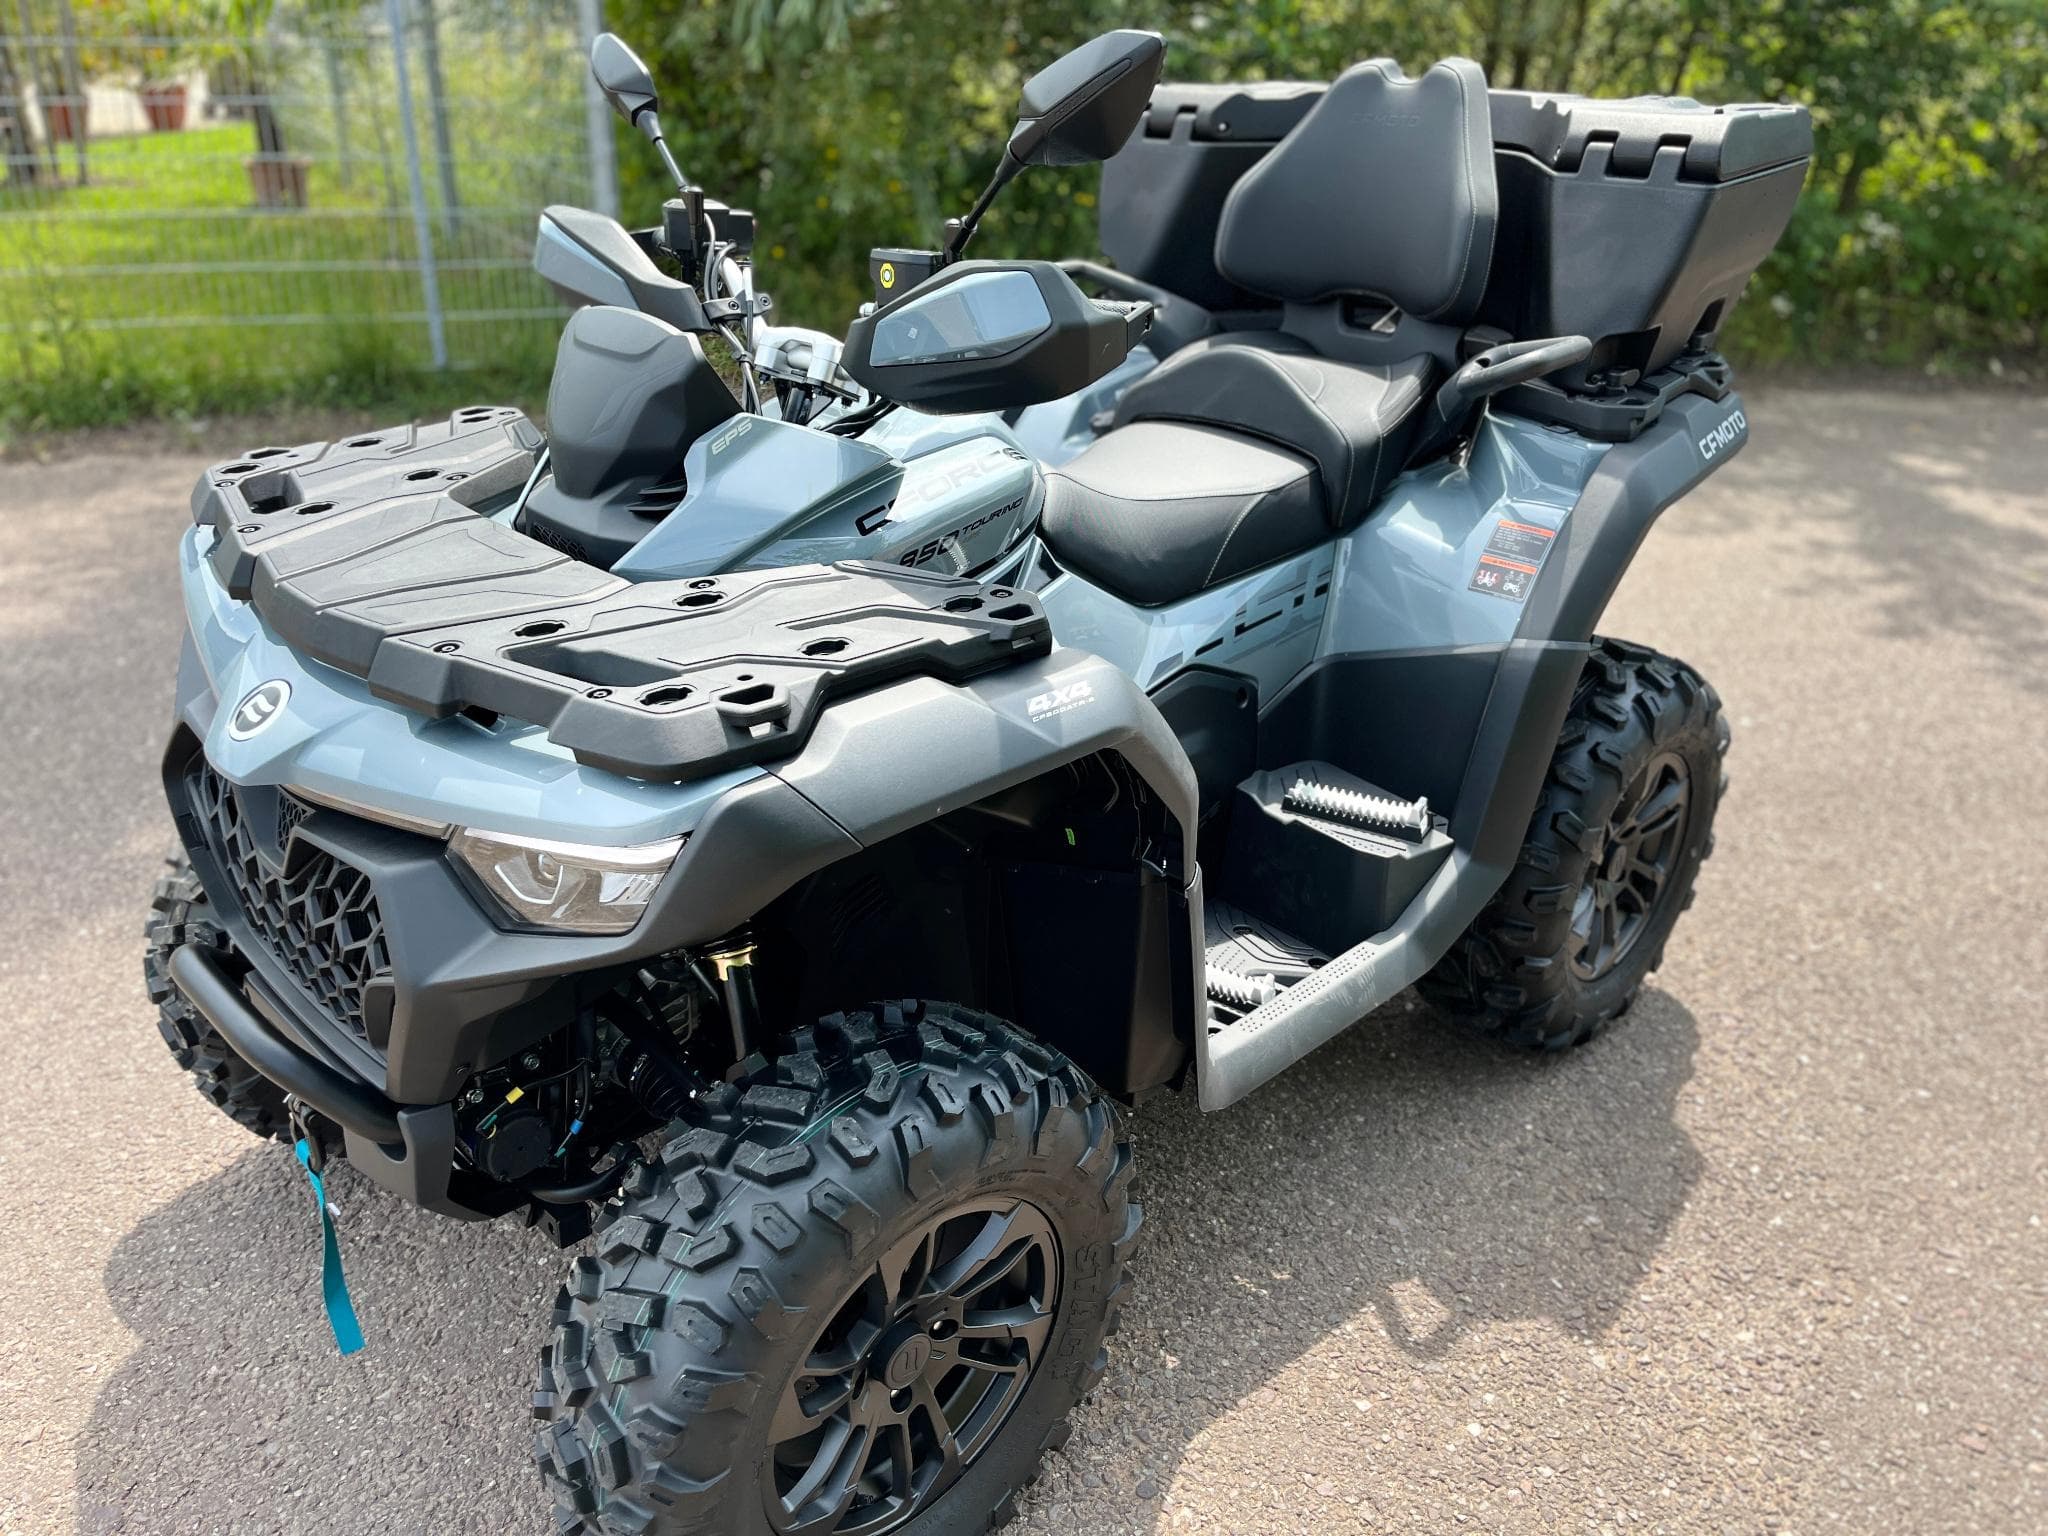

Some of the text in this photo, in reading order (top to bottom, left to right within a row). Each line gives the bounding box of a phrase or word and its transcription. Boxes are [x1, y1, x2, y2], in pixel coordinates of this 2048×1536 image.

[711, 419, 752, 455] EPS
[1698, 410, 1746, 460] CFMOTO
[962, 497, 1024, 535] TOURING
[1026, 680, 1092, 716] 4X4
